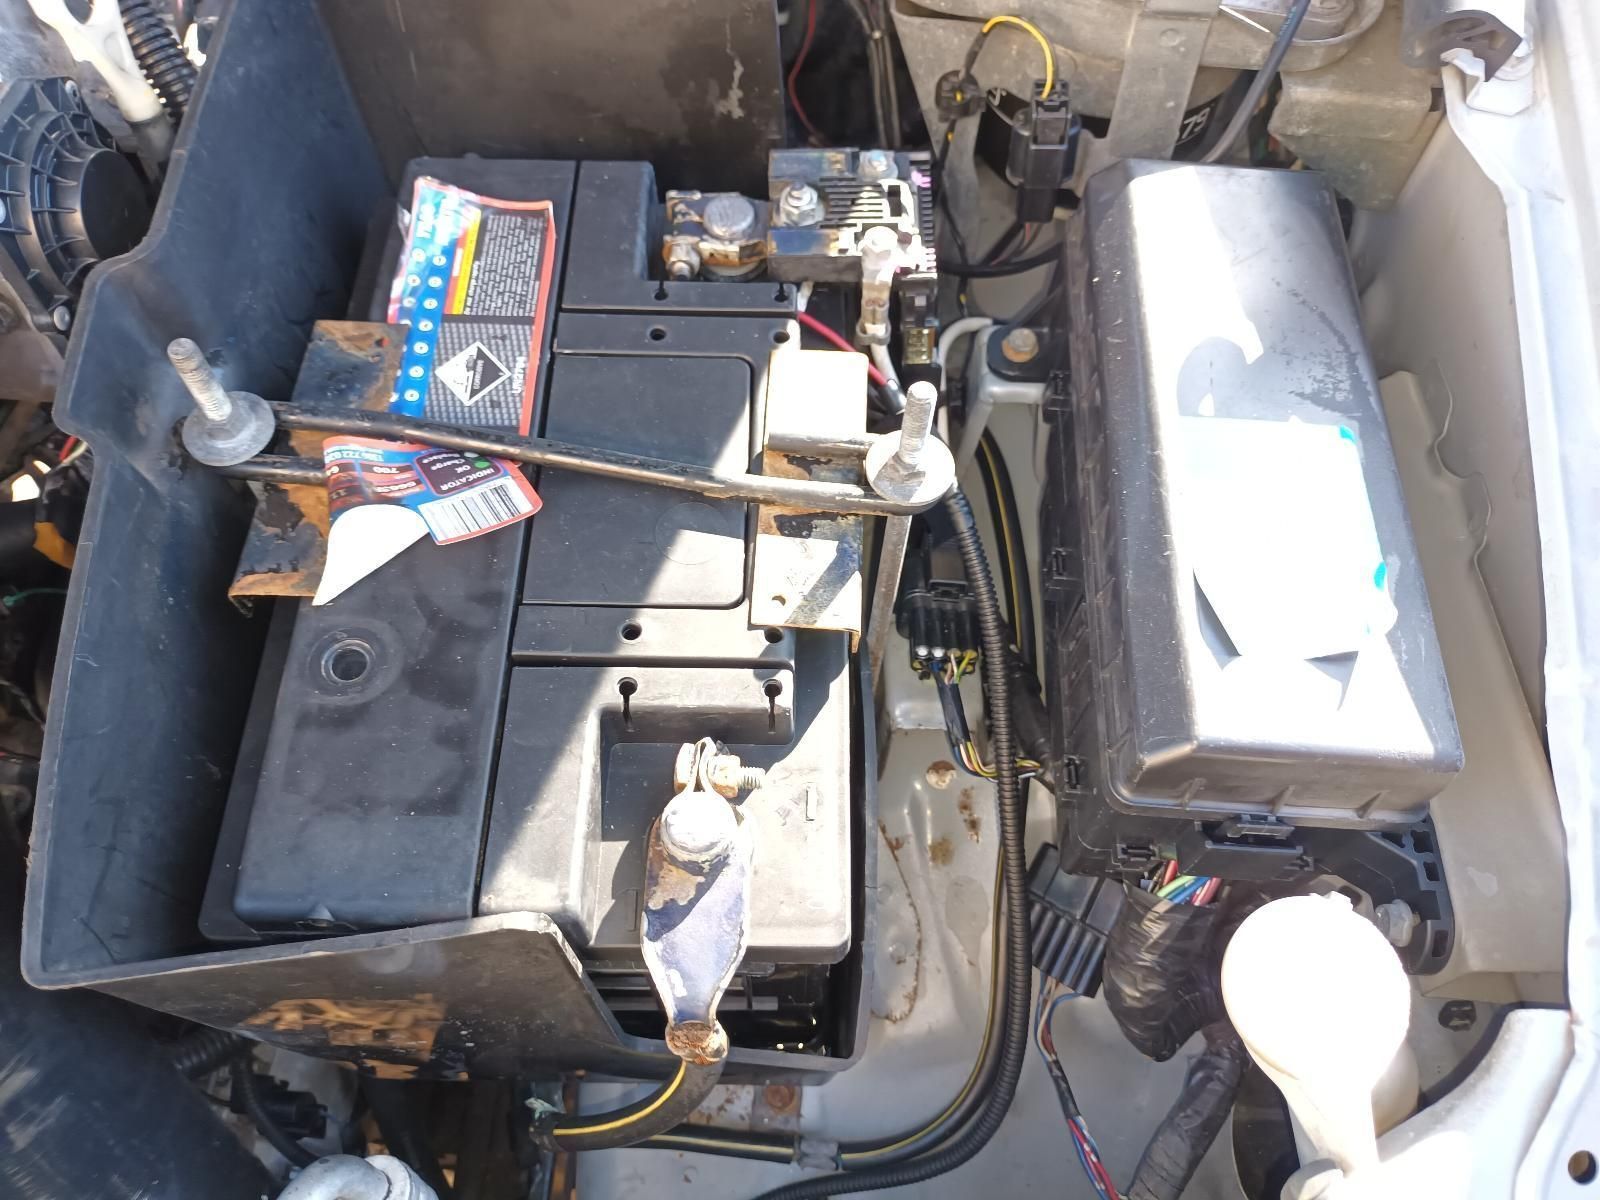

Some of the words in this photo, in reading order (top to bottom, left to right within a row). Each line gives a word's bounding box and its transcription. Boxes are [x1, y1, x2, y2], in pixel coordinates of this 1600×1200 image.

[431, 459, 466, 471] Charge
[457, 465, 471, 474] OK
[440, 467, 495, 491] INDICATOR
